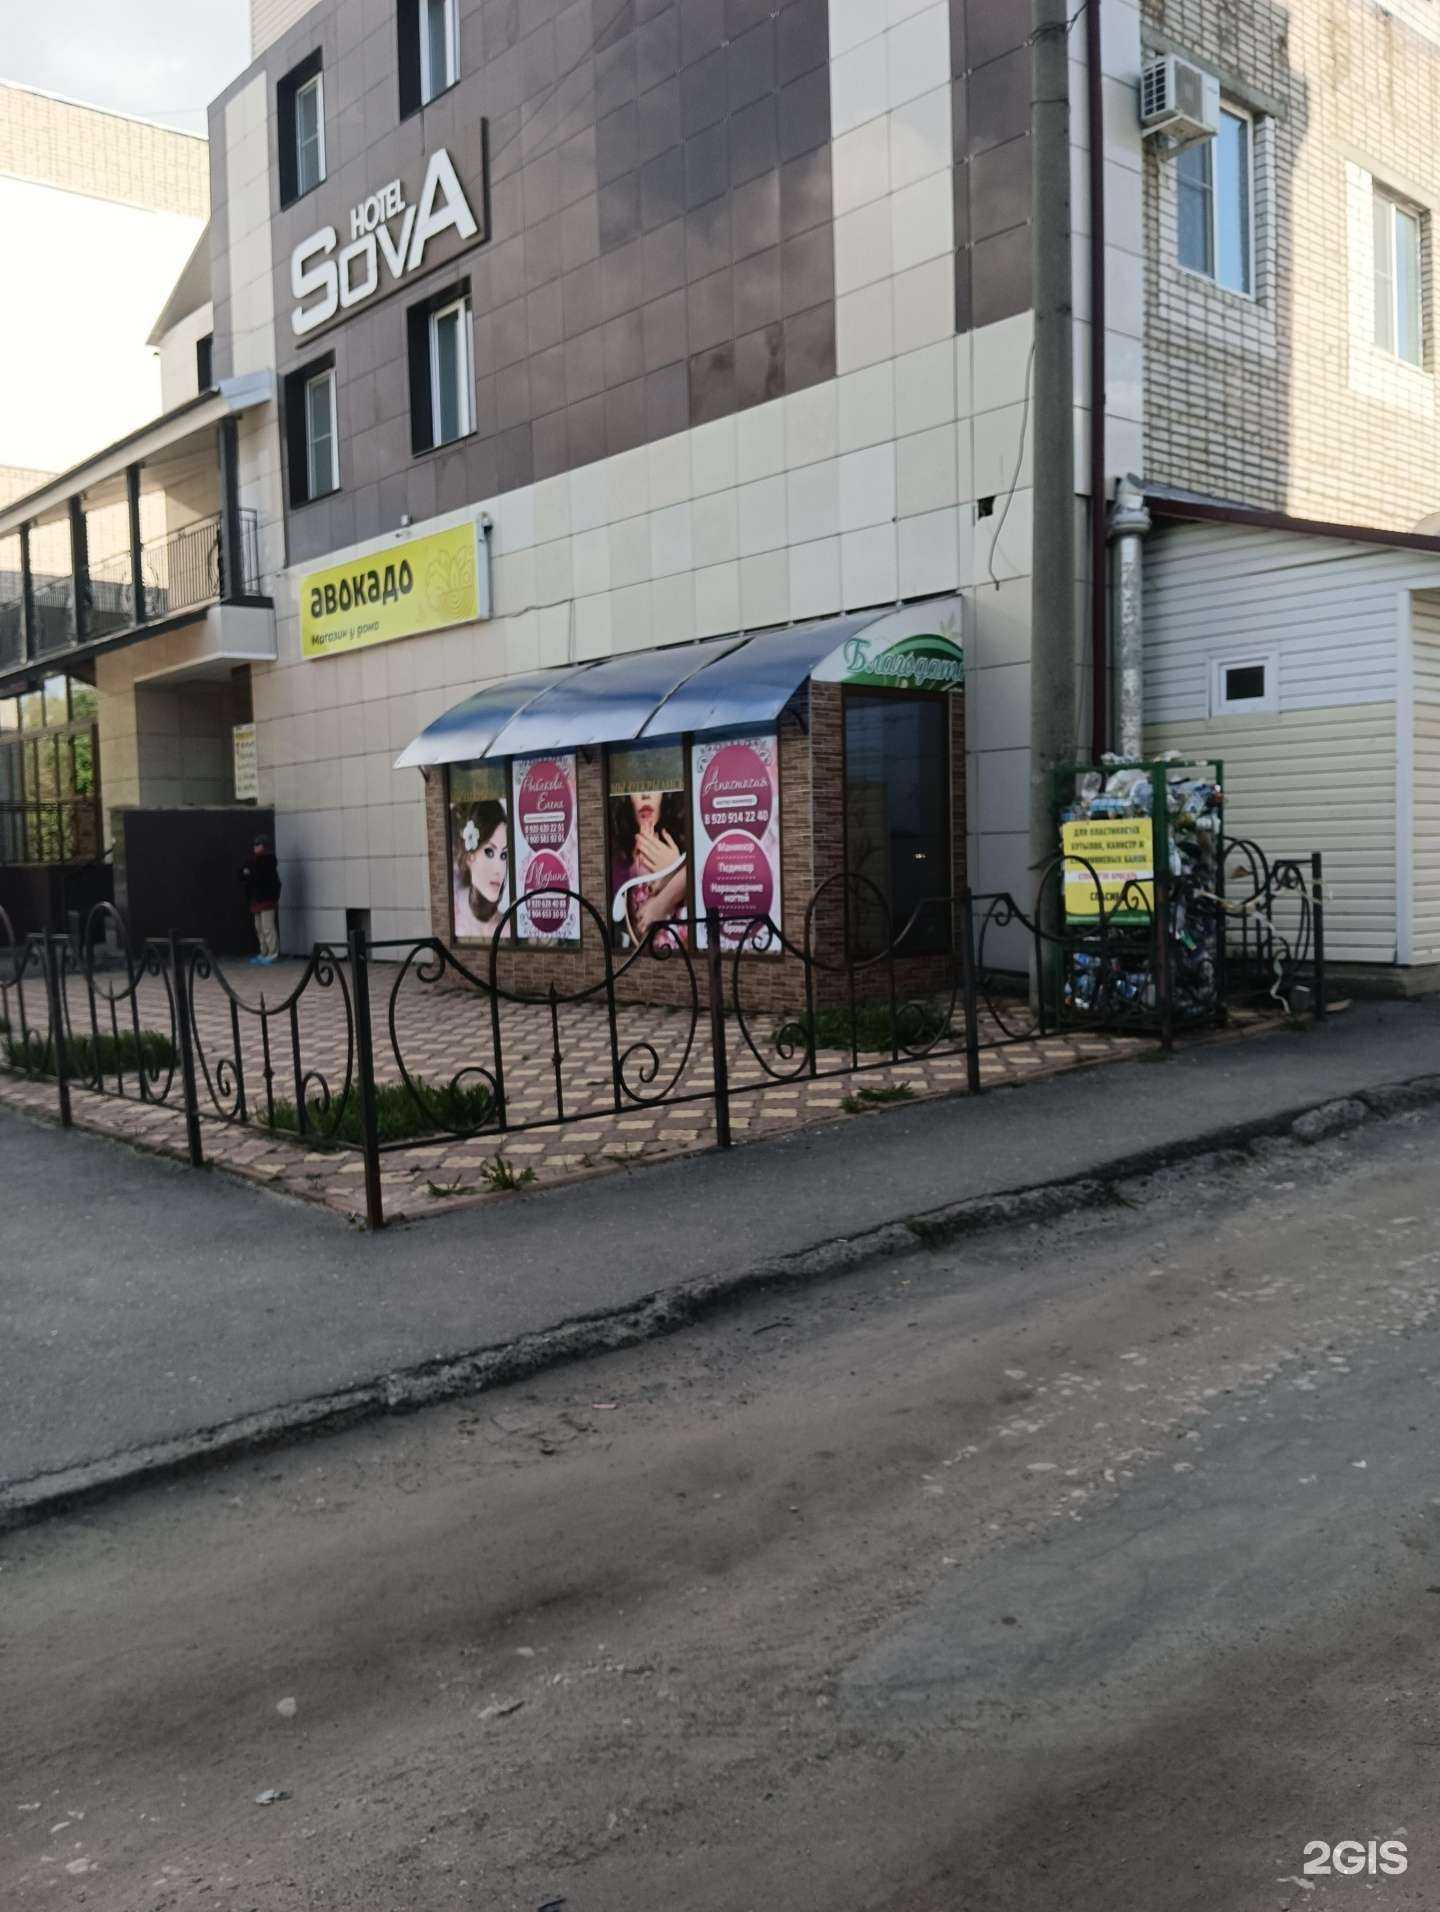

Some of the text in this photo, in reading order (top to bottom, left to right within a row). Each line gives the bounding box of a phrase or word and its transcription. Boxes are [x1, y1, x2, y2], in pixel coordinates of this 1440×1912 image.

[351, 178, 405, 240] HOTEL
[311, 559, 414, 619] авокадо
[705, 814, 710, 825] 8
[711, 813, 727, 825] 920
[728, 812, 743, 824] 914
[745, 811, 756, 823] 22
